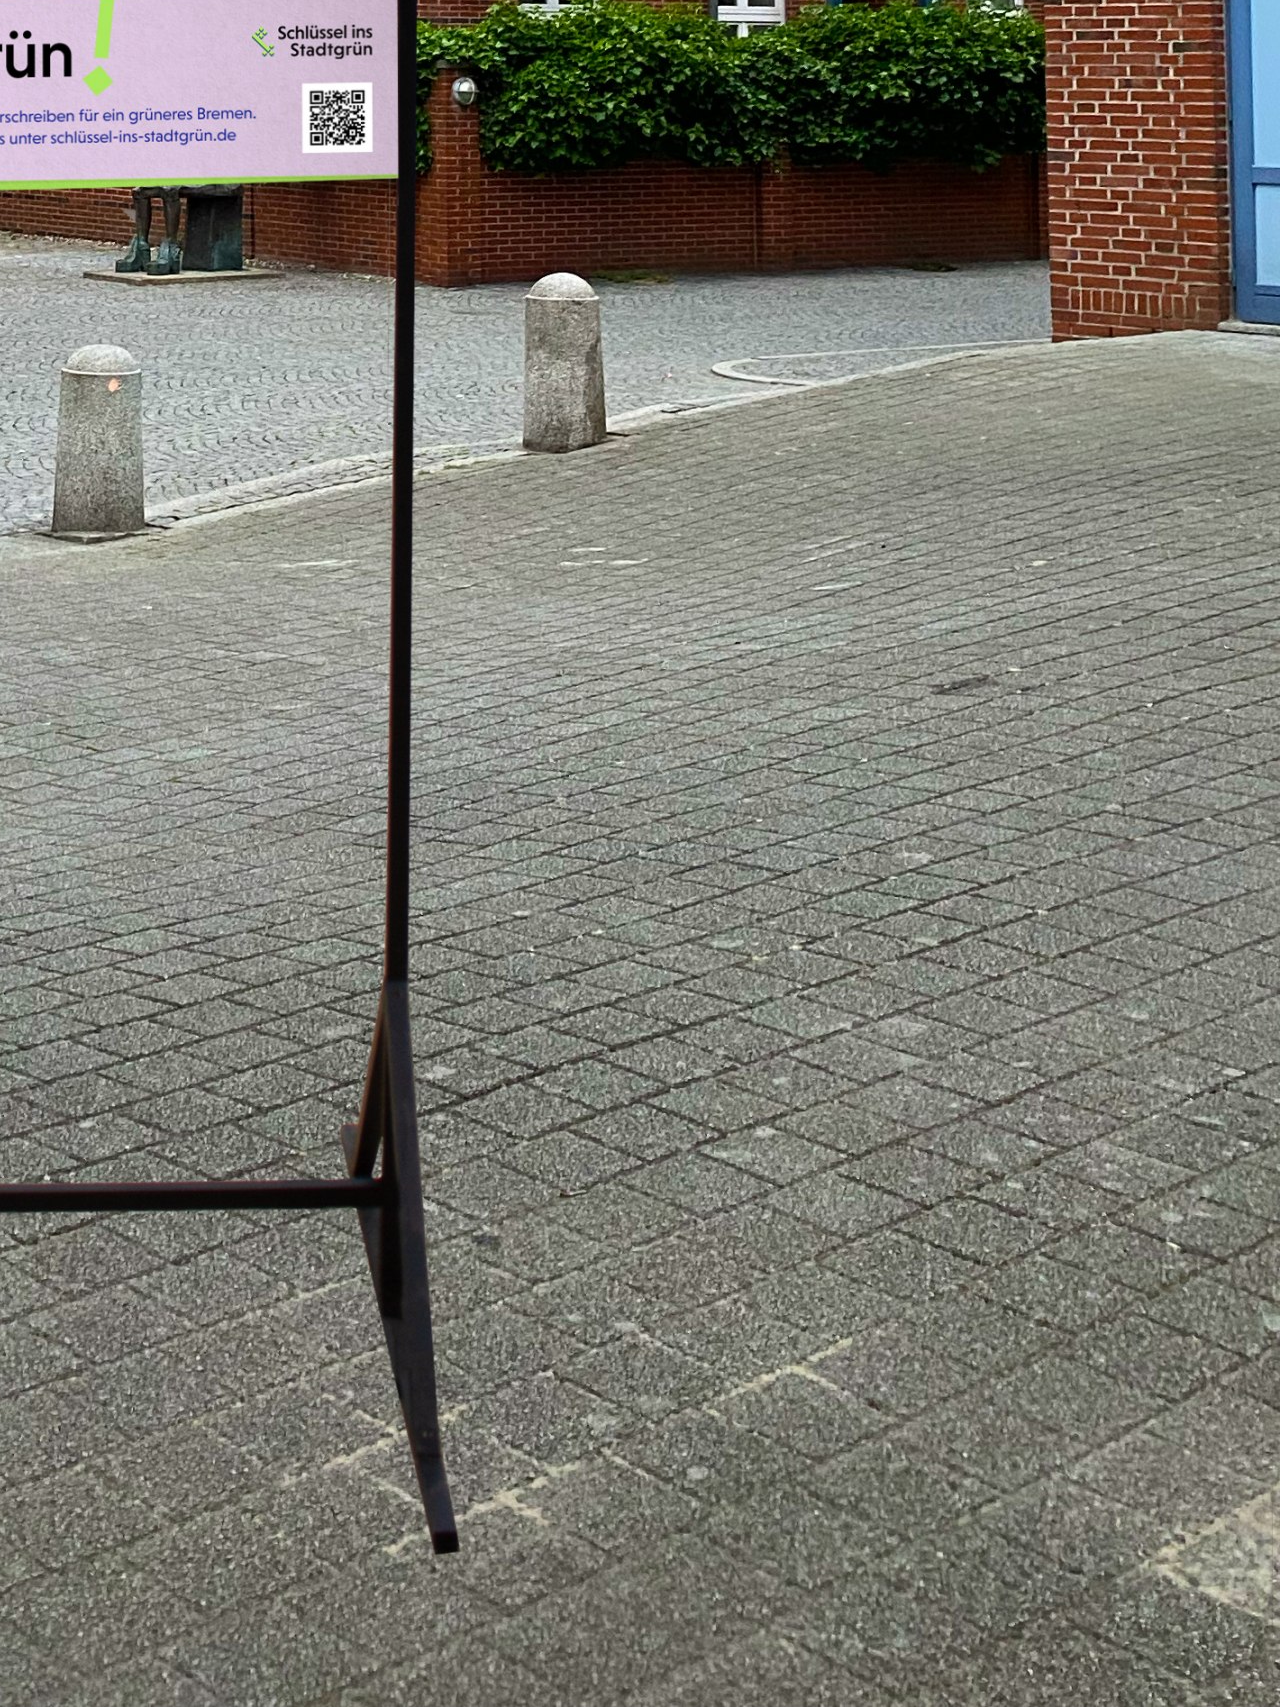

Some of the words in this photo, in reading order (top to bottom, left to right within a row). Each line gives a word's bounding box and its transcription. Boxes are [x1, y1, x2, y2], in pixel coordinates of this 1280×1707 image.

[277, 24, 348, 41] Schlüssel
[351, 23, 373, 39] ins
[290, 41, 373, 60] Stadtgrün
[78, 108, 100, 122] für
[102, 109, 125, 122] ein
[128, 108, 193, 125] grüneres
[197, 106, 257, 120] Bremen.
[9, 132, 48, 145] unter
[50, 128, 237, 145] schlüssel-ins-stadtgrün.de
